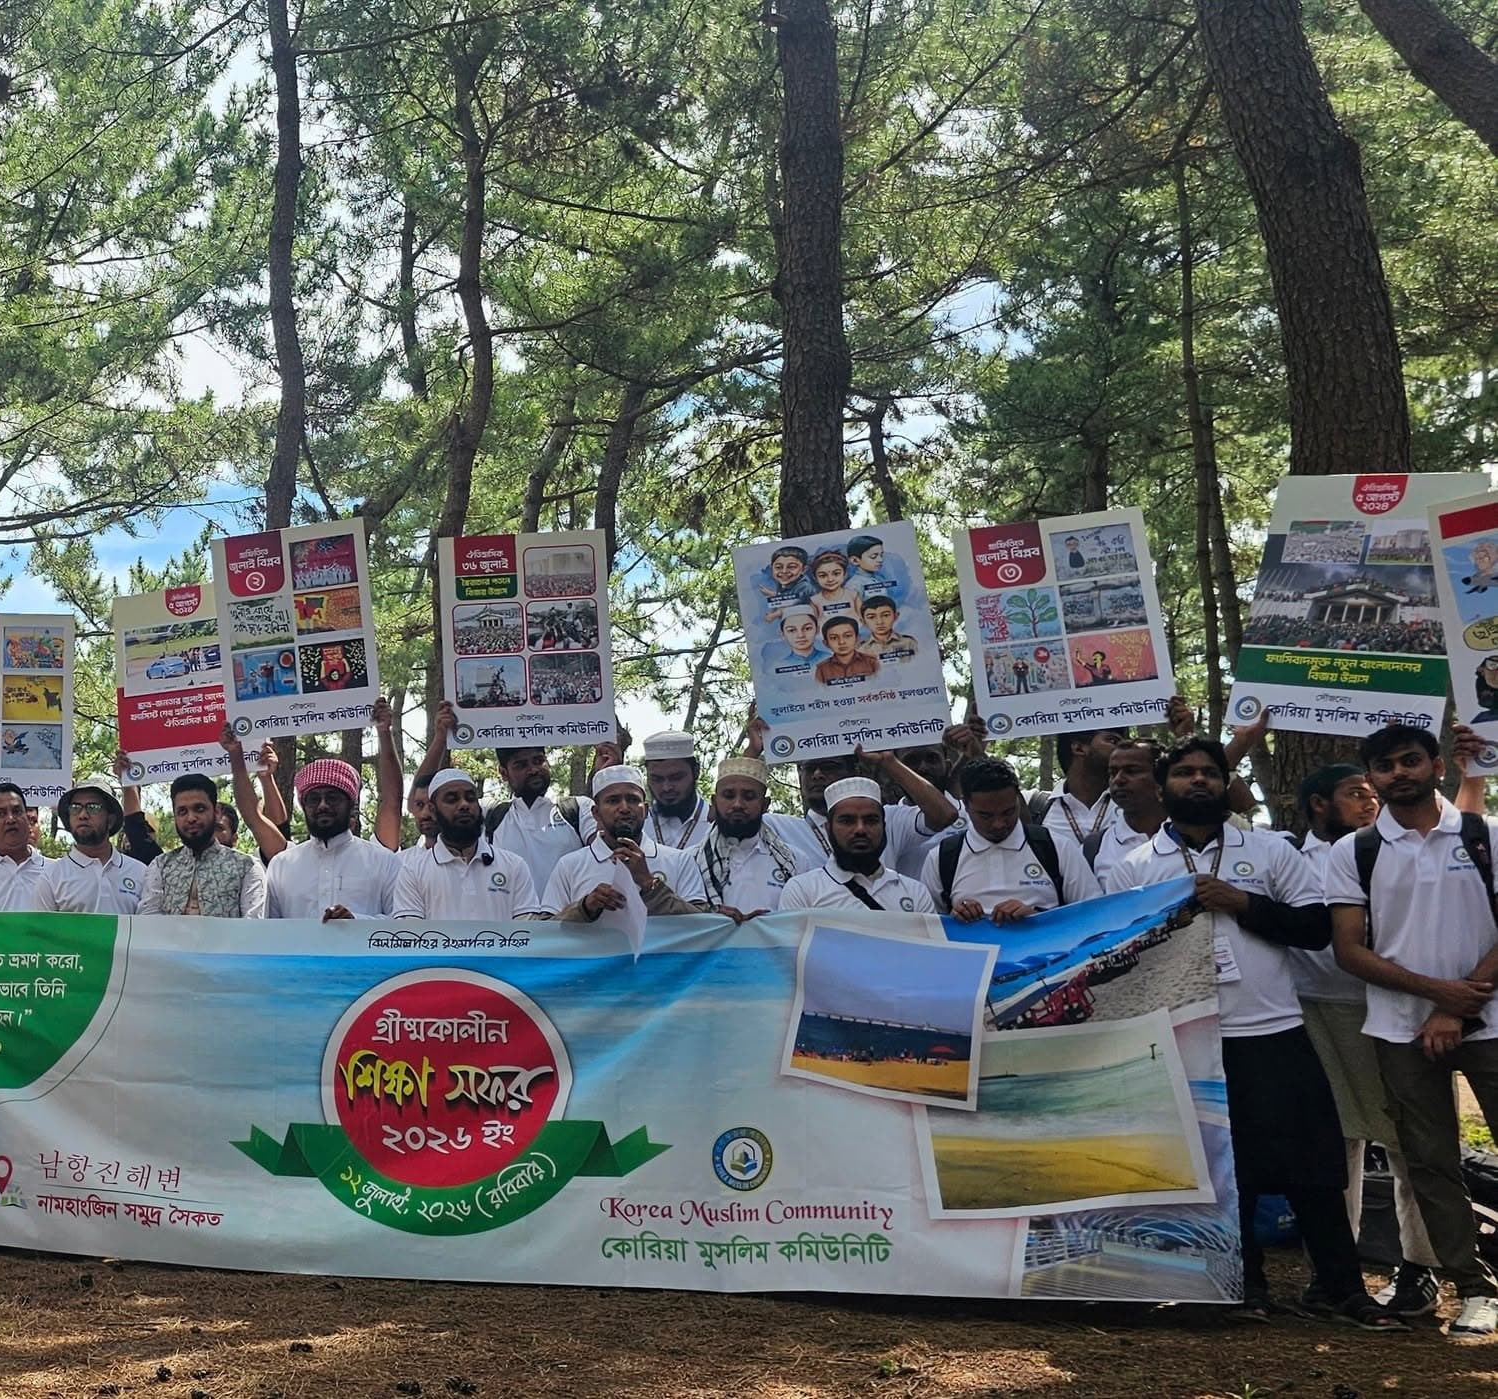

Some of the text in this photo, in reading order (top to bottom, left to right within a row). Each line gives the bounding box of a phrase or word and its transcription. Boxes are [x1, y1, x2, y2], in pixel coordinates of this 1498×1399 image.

[229, 556, 281, 573] জুলাই বিপ্লব
[479, 558, 509, 573] জুলাই
[975, 546, 1040, 566] জুলাই বিপ্লব
[1307, 669, 1370, 684] বিজয় উল্লাস
[1333, 657, 1358, 671] নতুন
[1359, 660, 1422, 673] বাংলাদেশের
[808, 699, 830, 711] শহীদ
[833, 697, 855, 708] হওয়া
[857, 689, 896, 704] সর্বকনিষ্ঠ
[254, 704, 375, 729] কোরিয়া মুসলিম কমিউনিটি
[1015, 698, 1169, 726] কোরিয়া মুসলিম কমিউনিটি
[1267, 702, 1311, 719] কোরিয়া
[1315, 707, 1360, 722] মুসলিম
[476, 720, 609, 739] কোরিয়া মুসলিম কমিউনিটি
[797, 718, 945, 749] কোরিয়া মুসলিম কমিউনিটি
[147, 757, 213, 774] কোরিয়া মুসলিম
[8, 952, 41, 970] ভ্রমণ
[45, 952, 84, 973] করো,
[33, 977, 67, 999] তিনি
[371, 1008, 510, 1045] গ্রীষ্মকালীন
[338, 1050, 554, 1111] শিক্ষা সফর
[381, 1120, 515, 1154] ২০২৬ ইং
[38, 1150, 182, 1193] 남항진해변
[340, 1152, 557, 1223] ১২ জুলাই, ২০২৬ (রবিবার)
[36, 1194, 224, 1228] নামহাংজিন সমুদ্র সৈকত
[600, 1196, 894, 1230] Korea Muslim Community
[601, 1230, 894, 1271] কোরিয়া মুসলিম কমিউনিটি
